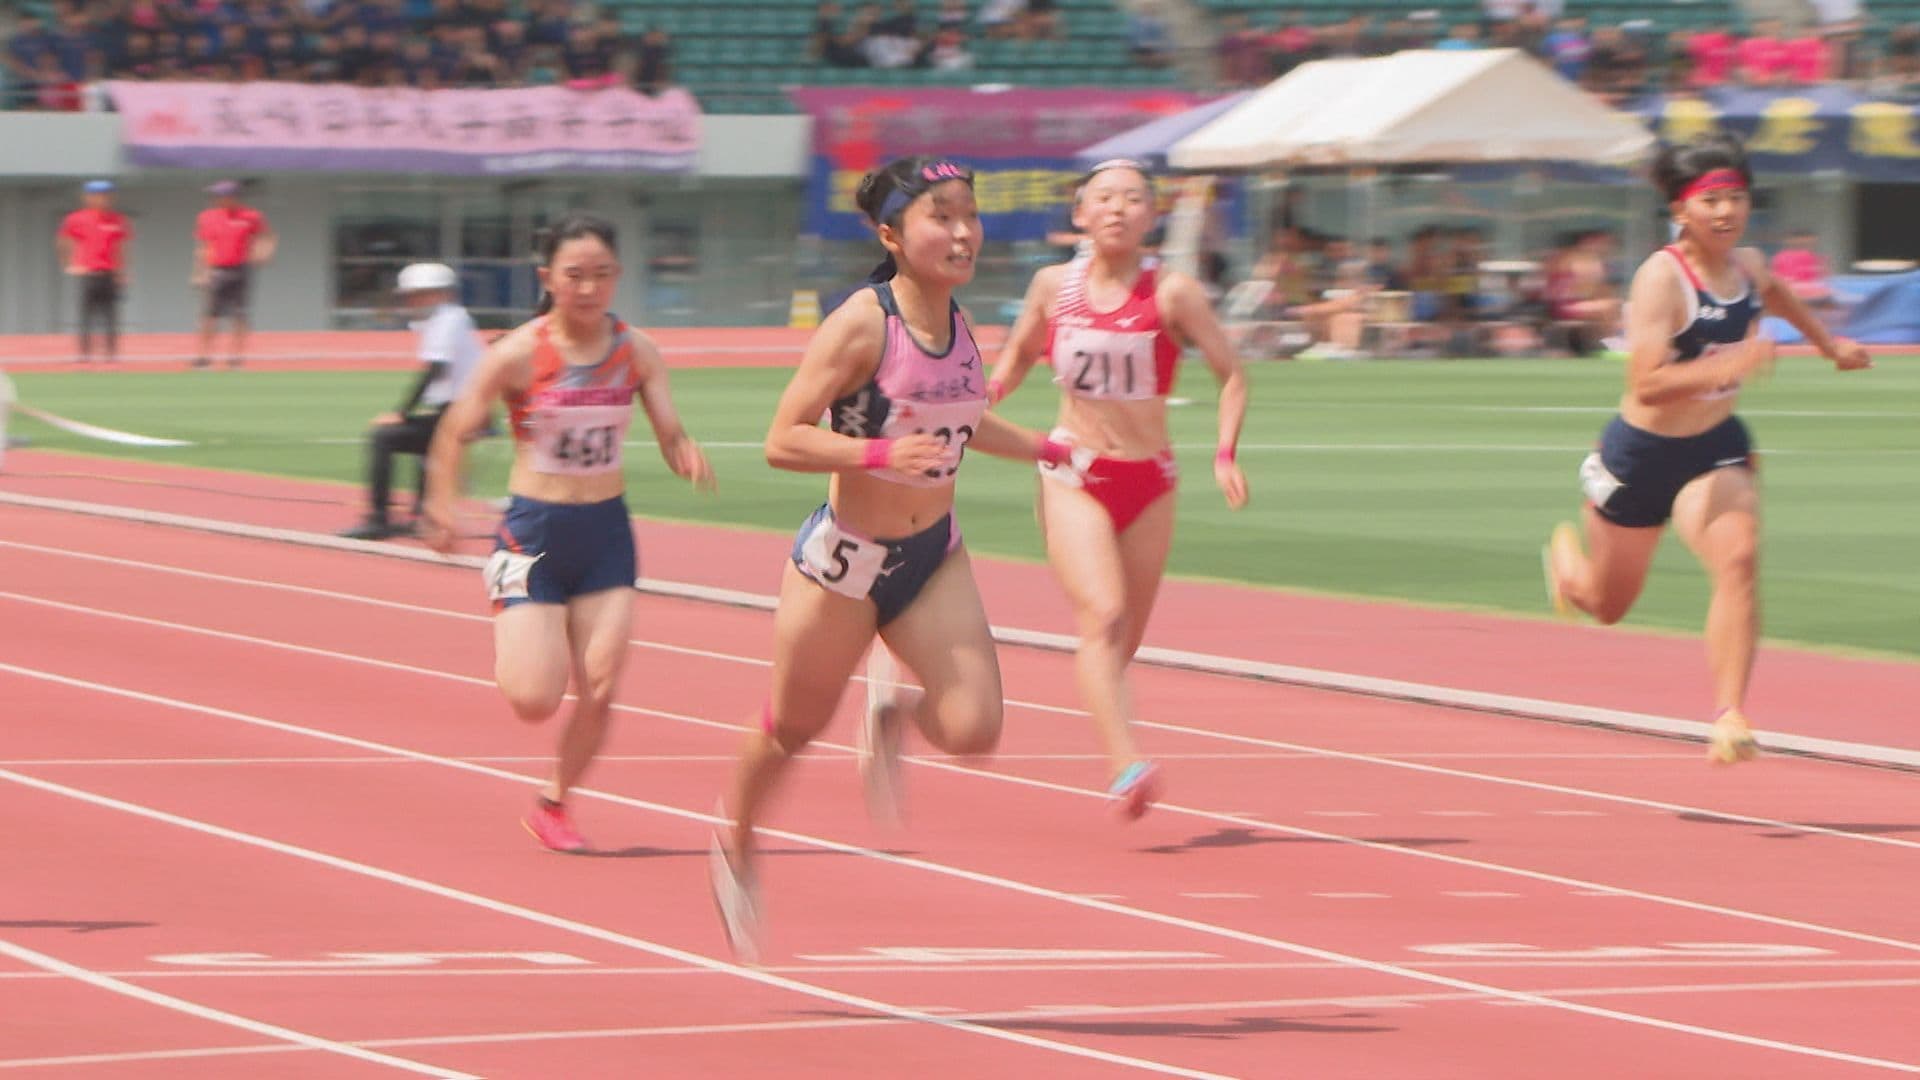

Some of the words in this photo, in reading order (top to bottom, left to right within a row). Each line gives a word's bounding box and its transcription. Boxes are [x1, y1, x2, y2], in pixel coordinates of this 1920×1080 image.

[1073, 351, 1135, 393] 211
[911, 424, 974, 479] 23
[821, 539, 859, 583] 5
